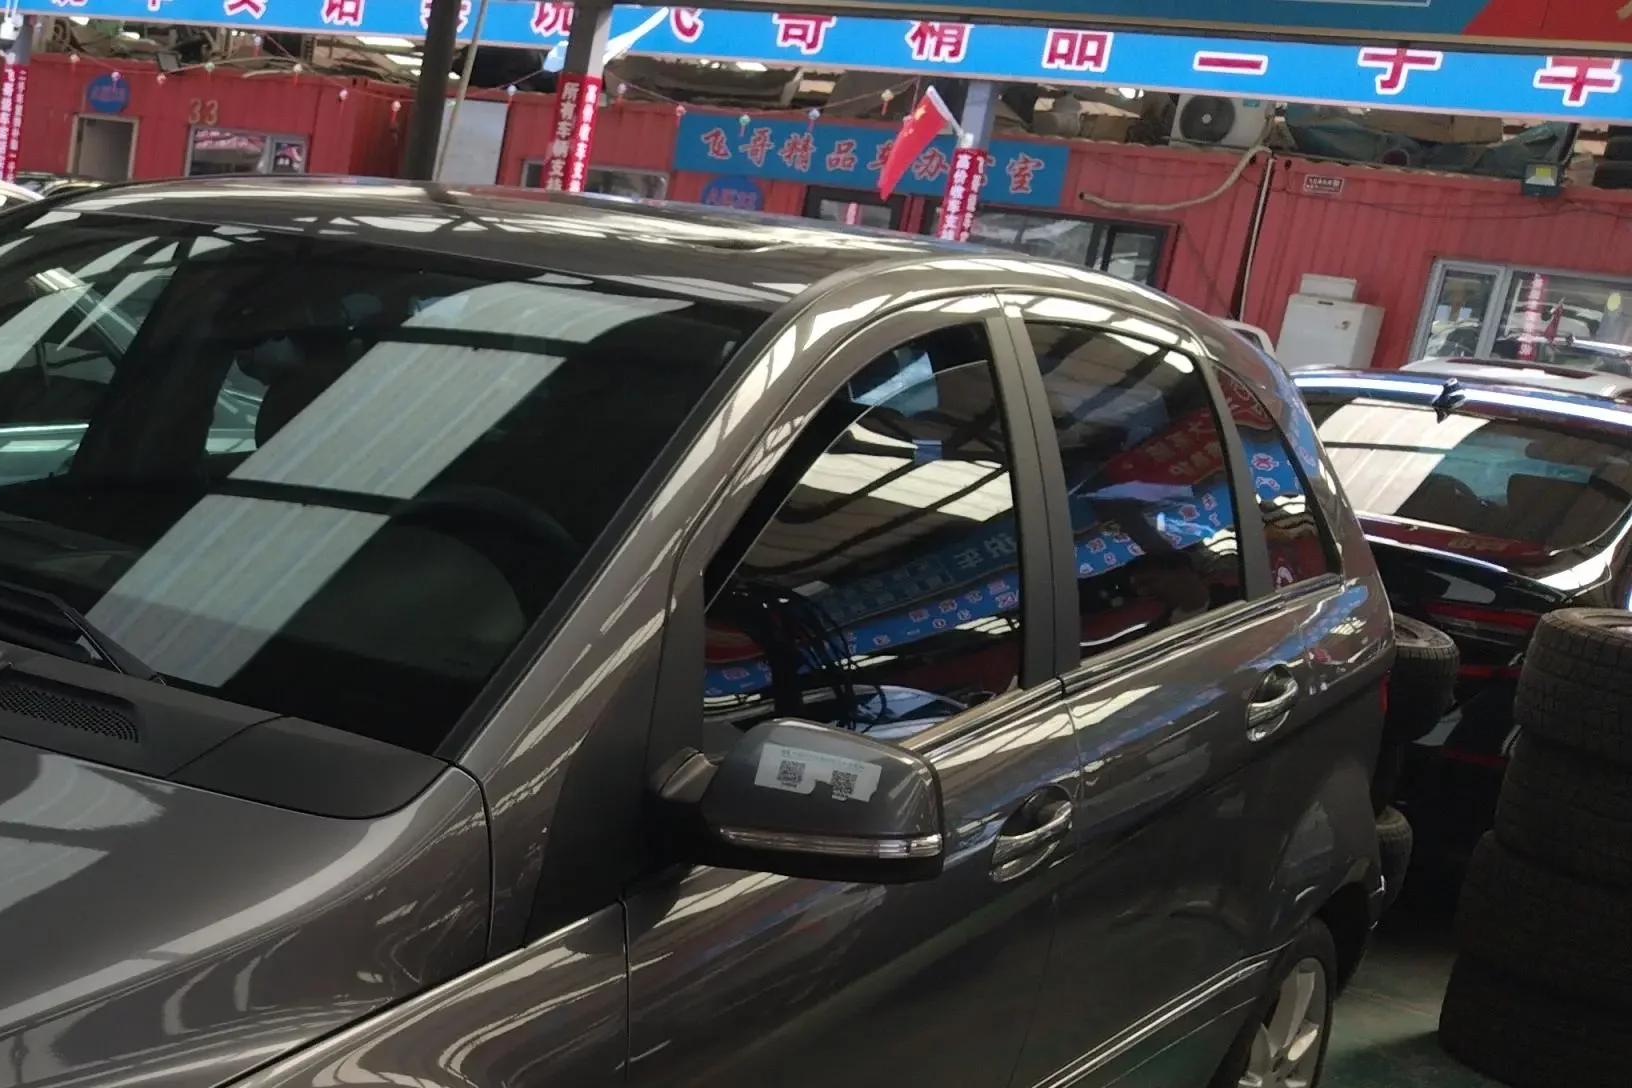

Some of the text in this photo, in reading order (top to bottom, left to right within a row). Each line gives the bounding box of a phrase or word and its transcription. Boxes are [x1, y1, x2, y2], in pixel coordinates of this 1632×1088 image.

[188, 99, 219, 125] 33
[701, 125, 1045, 194] 飞哥精品车办室
